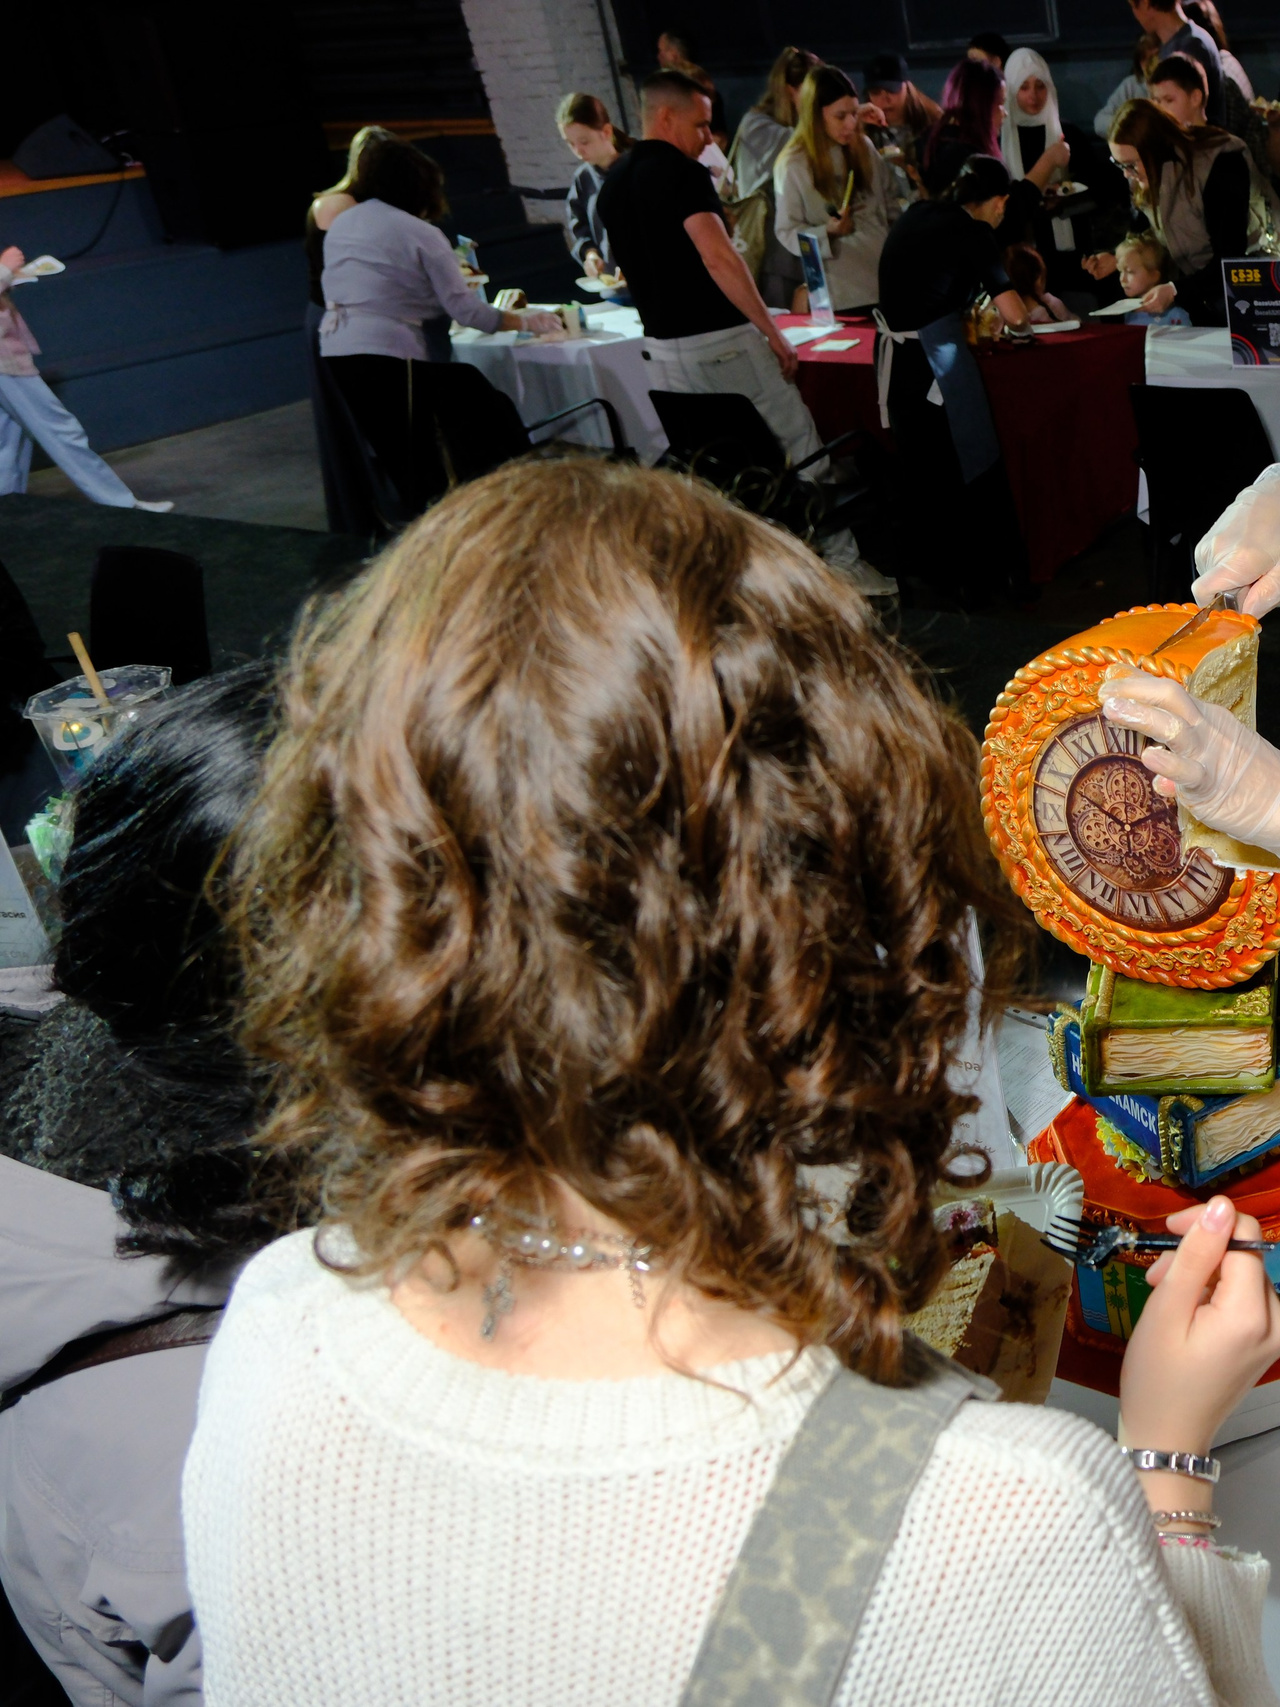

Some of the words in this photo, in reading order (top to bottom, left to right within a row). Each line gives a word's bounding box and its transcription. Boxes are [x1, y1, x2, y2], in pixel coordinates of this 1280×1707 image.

[1070, 731, 1099, 759] XI
[1107, 726, 1138, 756] XII
[1042, 801, 1062, 823] IX
[1053, 834, 1085, 877] VIII
[1088, 872, 1118, 907] VII
[1163, 891, 1187, 912] V
[1126, 893, 1151, 917] VI
